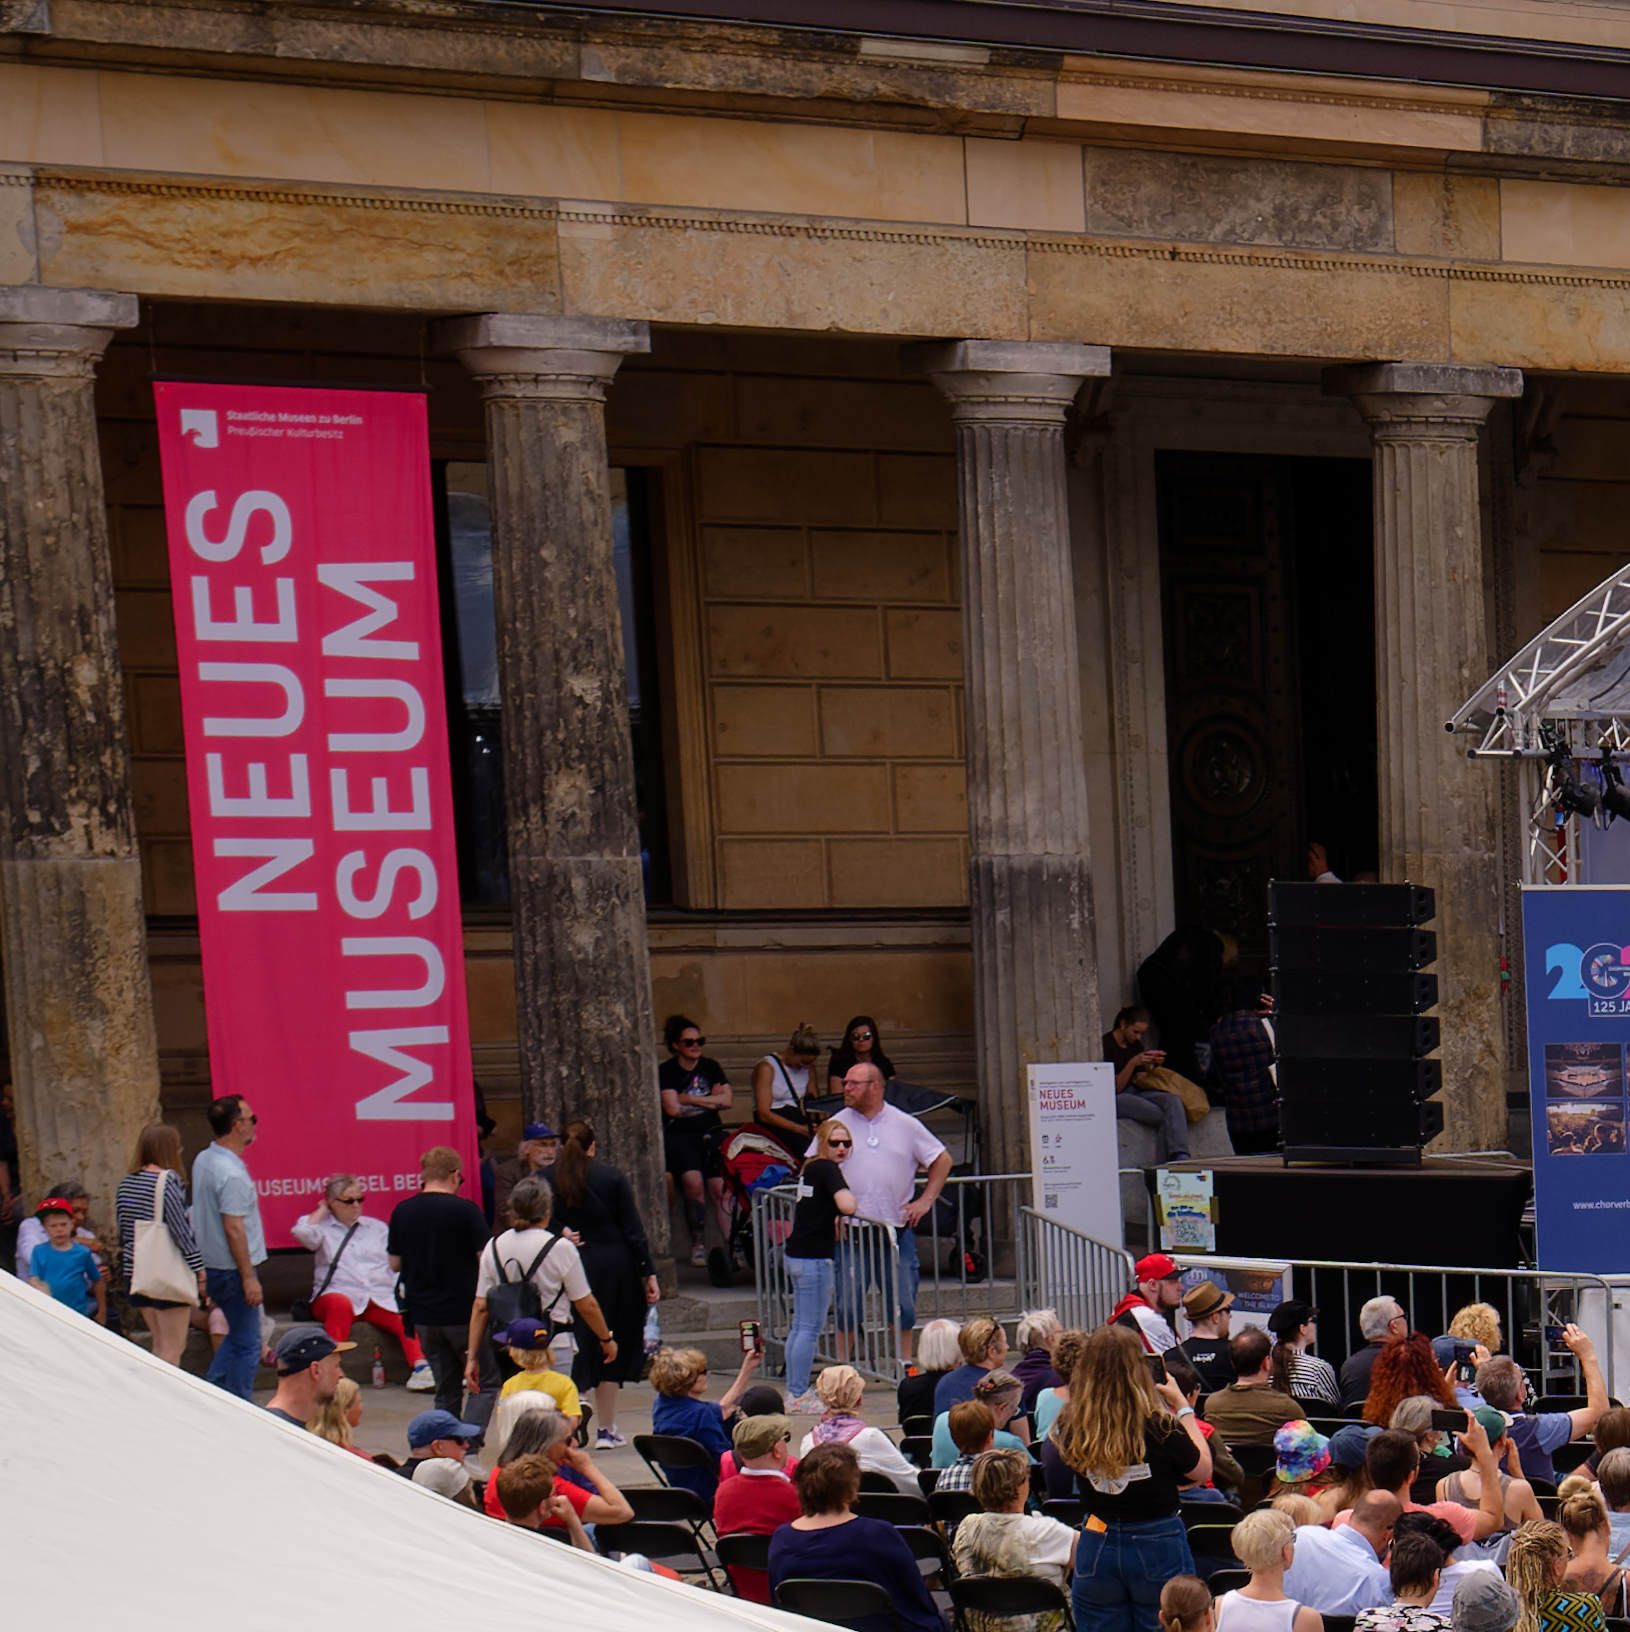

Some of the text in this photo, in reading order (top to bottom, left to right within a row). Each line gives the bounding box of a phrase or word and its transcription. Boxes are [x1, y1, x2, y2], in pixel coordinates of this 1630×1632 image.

[278, 412, 317, 423] Museen
[318, 415, 331, 424] zu
[333, 414, 363, 425] Berlin
[185, 489, 318, 912] NEUES
[316, 560, 455, 1122] MUSEUM
[1593, 1000, 1616, 1013] 125
[1039, 1088, 1074, 1100] NEUES
[1039, 1099, 1087, 1111] MUSEUM
